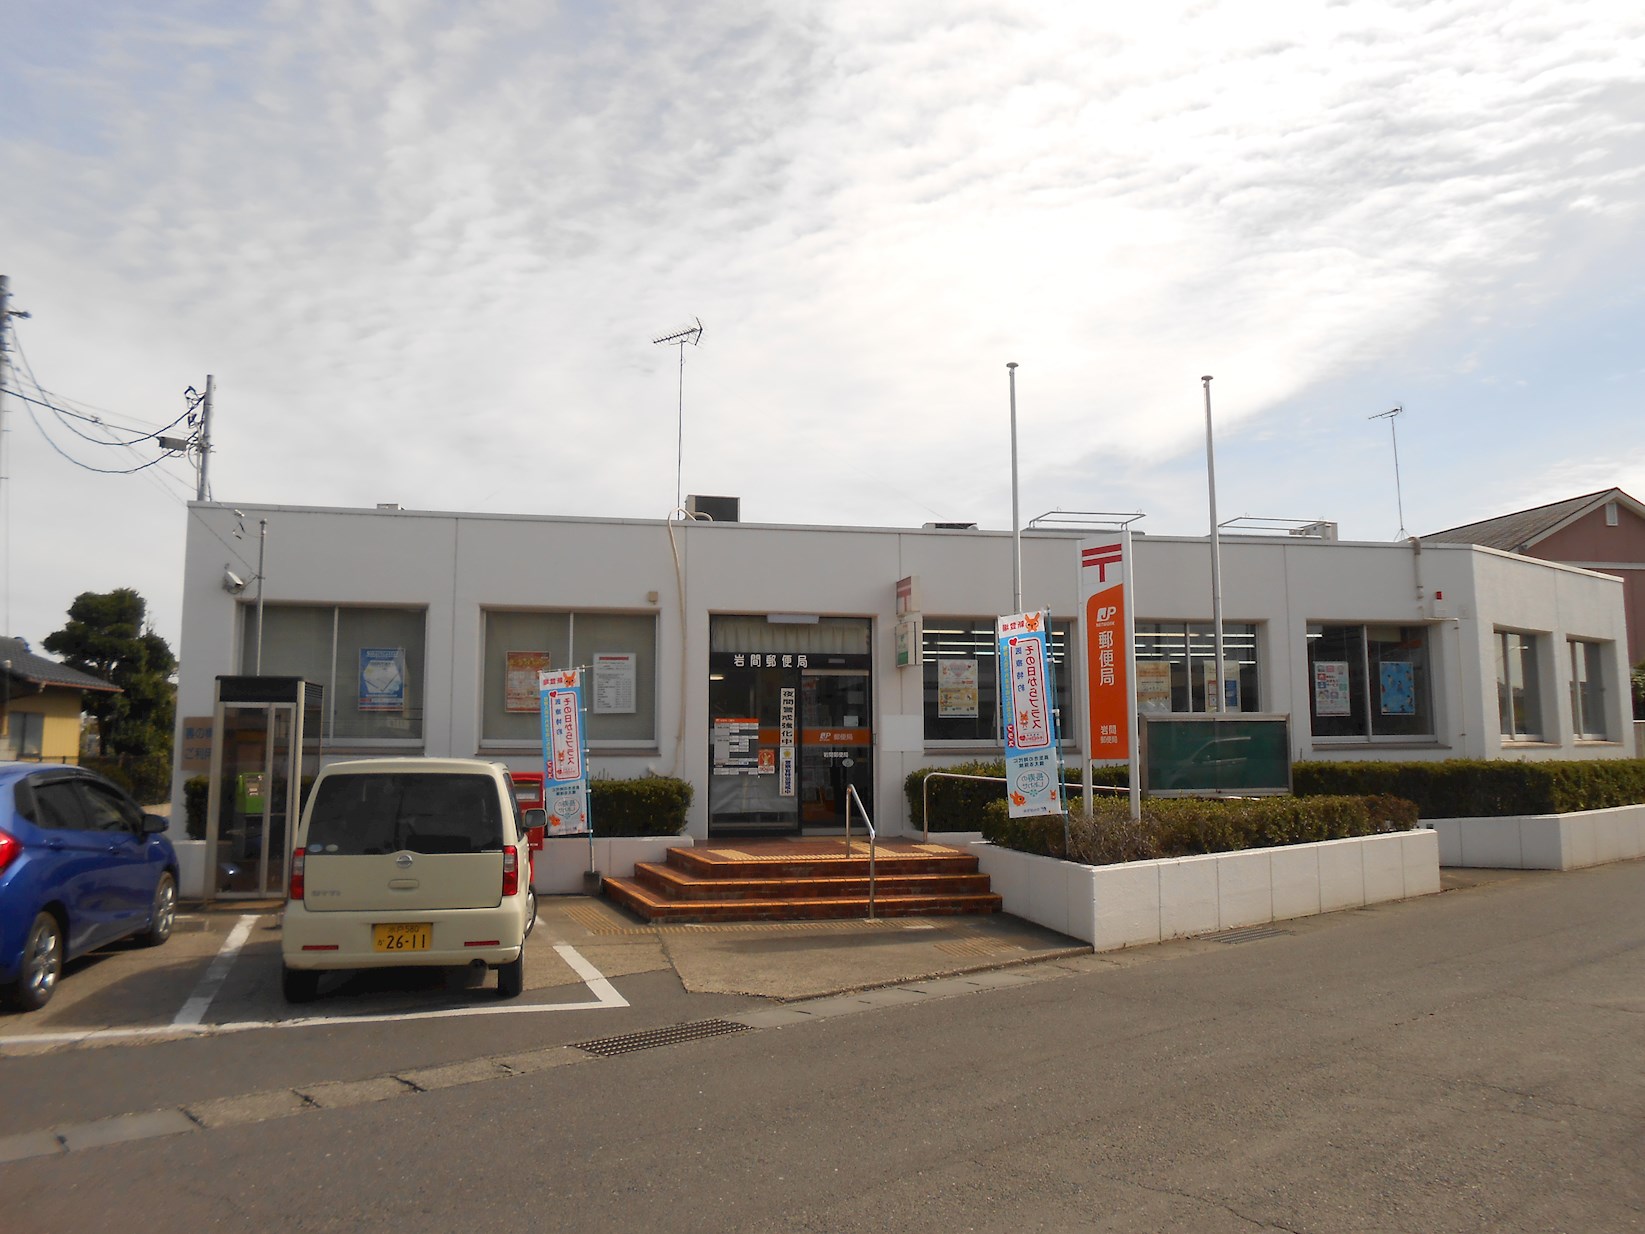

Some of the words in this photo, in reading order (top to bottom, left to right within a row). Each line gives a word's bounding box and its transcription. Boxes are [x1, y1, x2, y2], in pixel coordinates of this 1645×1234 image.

[733, 654, 808, 669] 岩間郵便局
[1098, 630, 1115, 686] 郵便局
[1100, 724, 1117, 735] 岩間
[386, 934, 426, 949] 26-11
